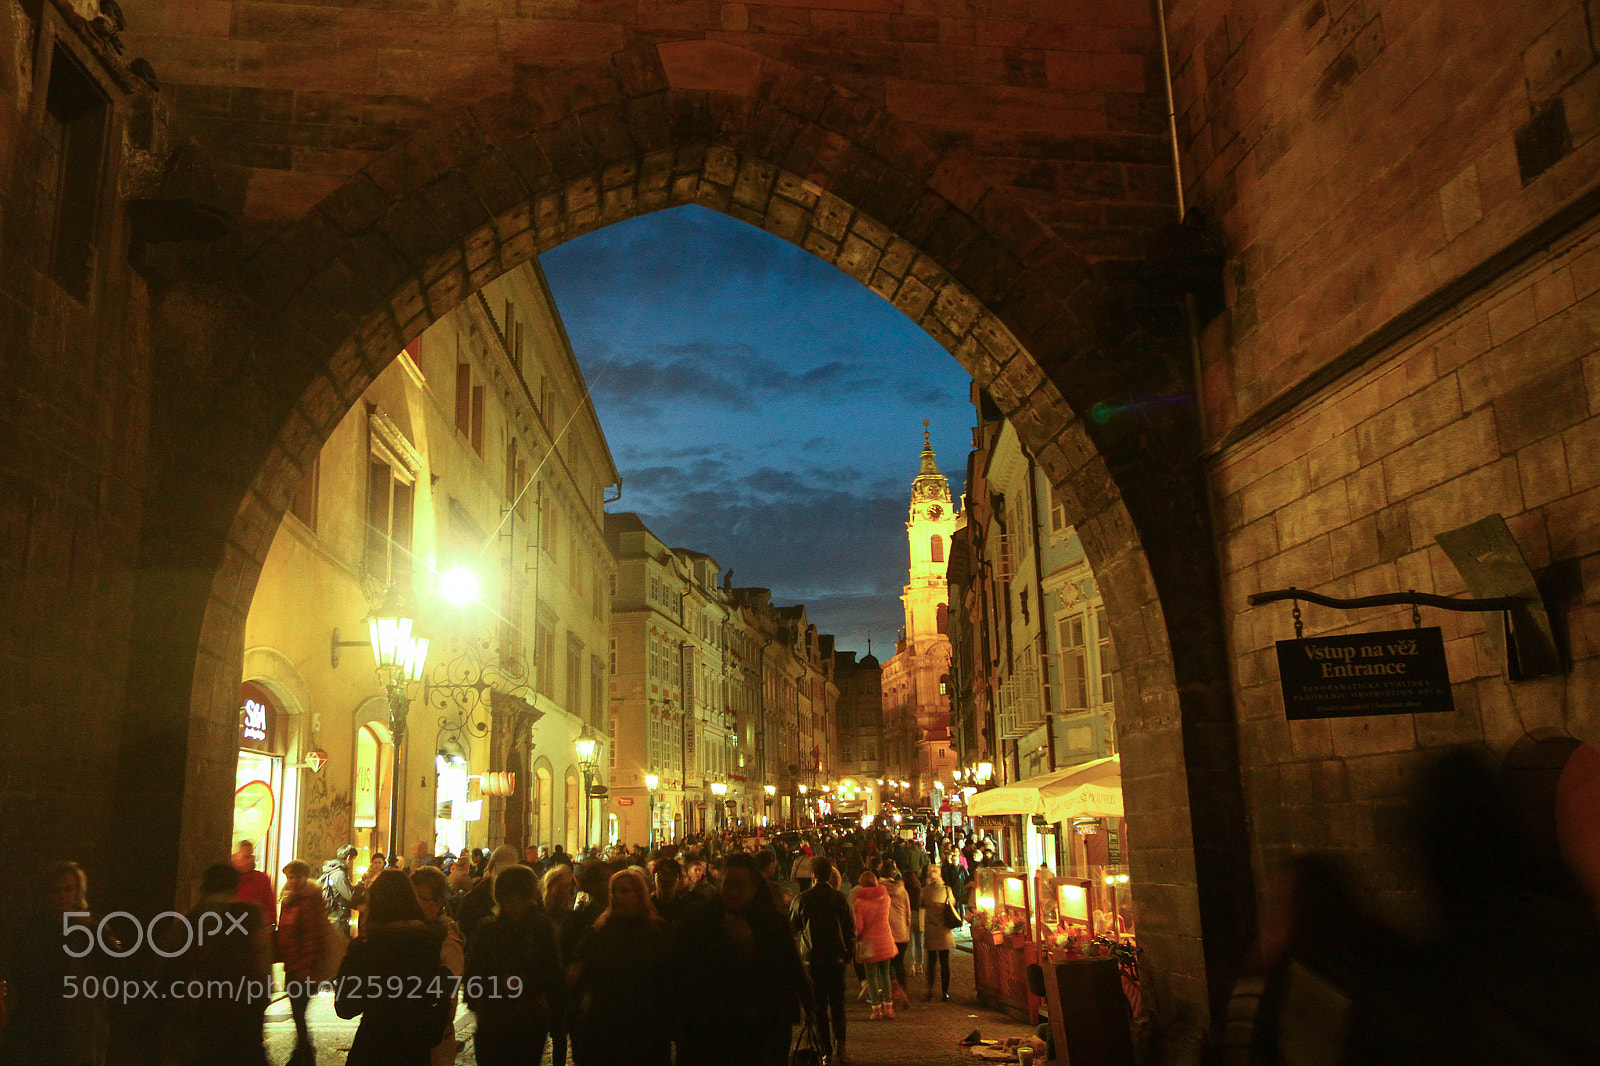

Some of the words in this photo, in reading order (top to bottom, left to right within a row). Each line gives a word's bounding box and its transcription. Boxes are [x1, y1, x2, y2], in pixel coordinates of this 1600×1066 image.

[1304, 644, 1356, 663] Vstup
[1360, 644, 1384, 658] na
[1387, 638, 1419, 657] věž
[1321, 662, 1407, 678] Entrance
